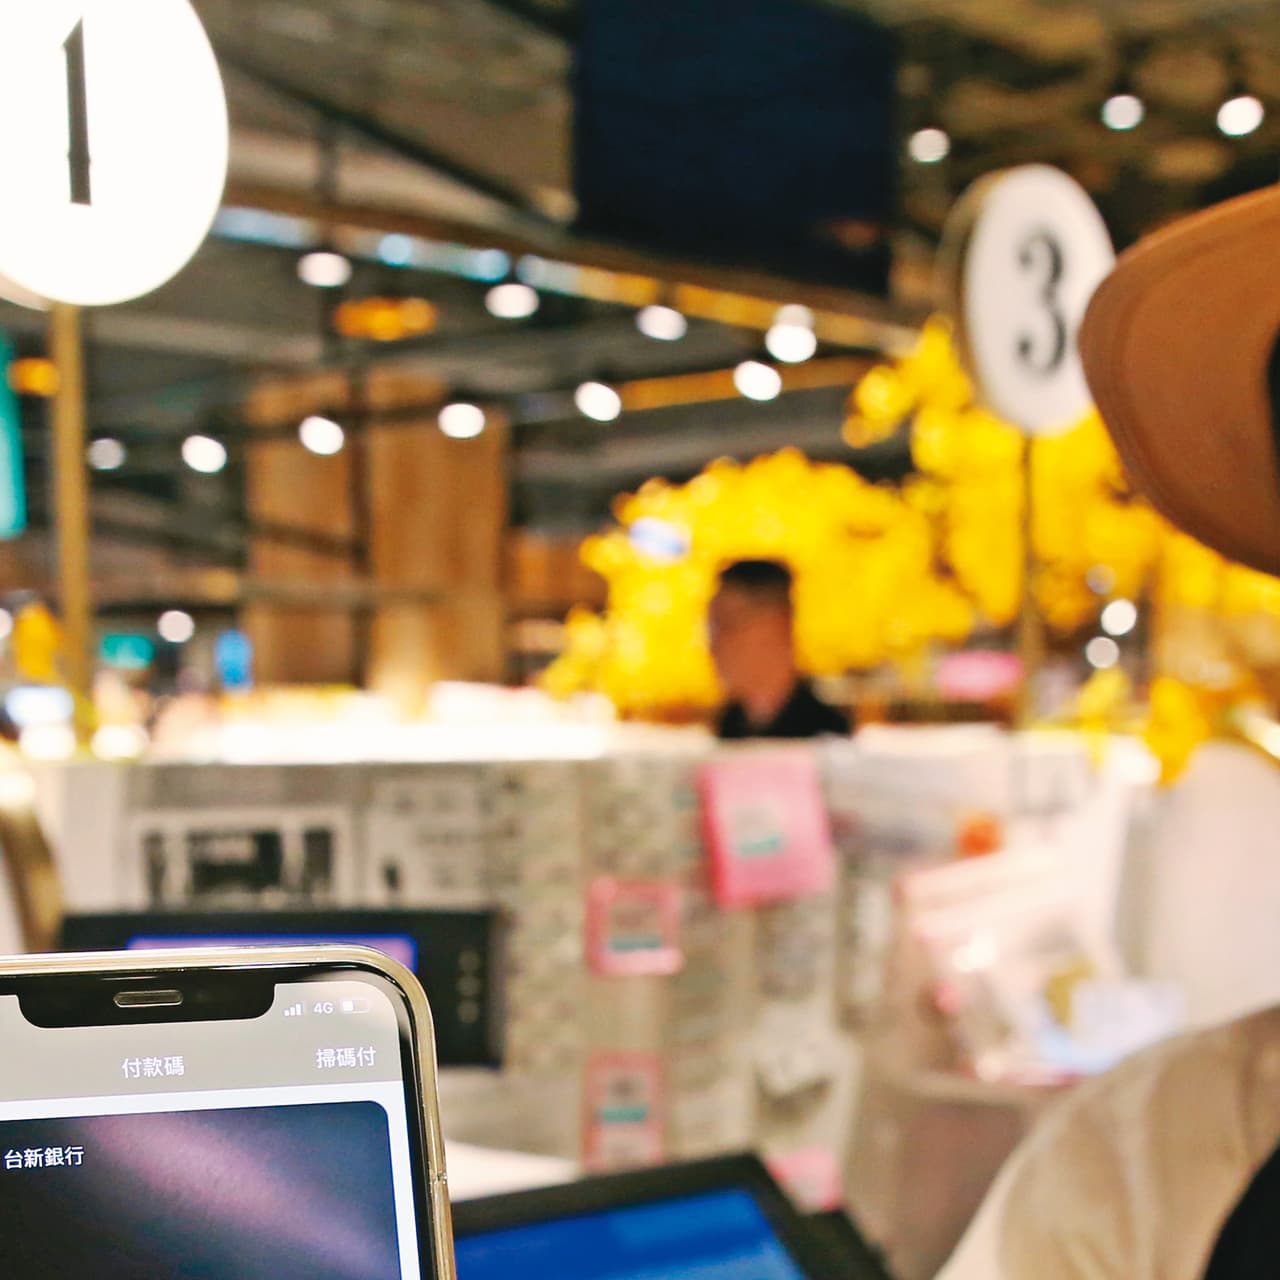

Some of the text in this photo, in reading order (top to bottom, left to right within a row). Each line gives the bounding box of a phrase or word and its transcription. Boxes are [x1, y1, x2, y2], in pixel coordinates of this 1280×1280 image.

[62, 17, 92, 206] 1
[1014, 225, 1068, 378] 3
[314, 1001, 333, 1015] 4G
[121, 1055, 185, 1079] 付款碼
[315, 1046, 377, 1069] 掃碼付
[3, 1146, 85, 1170] 台新銀行
